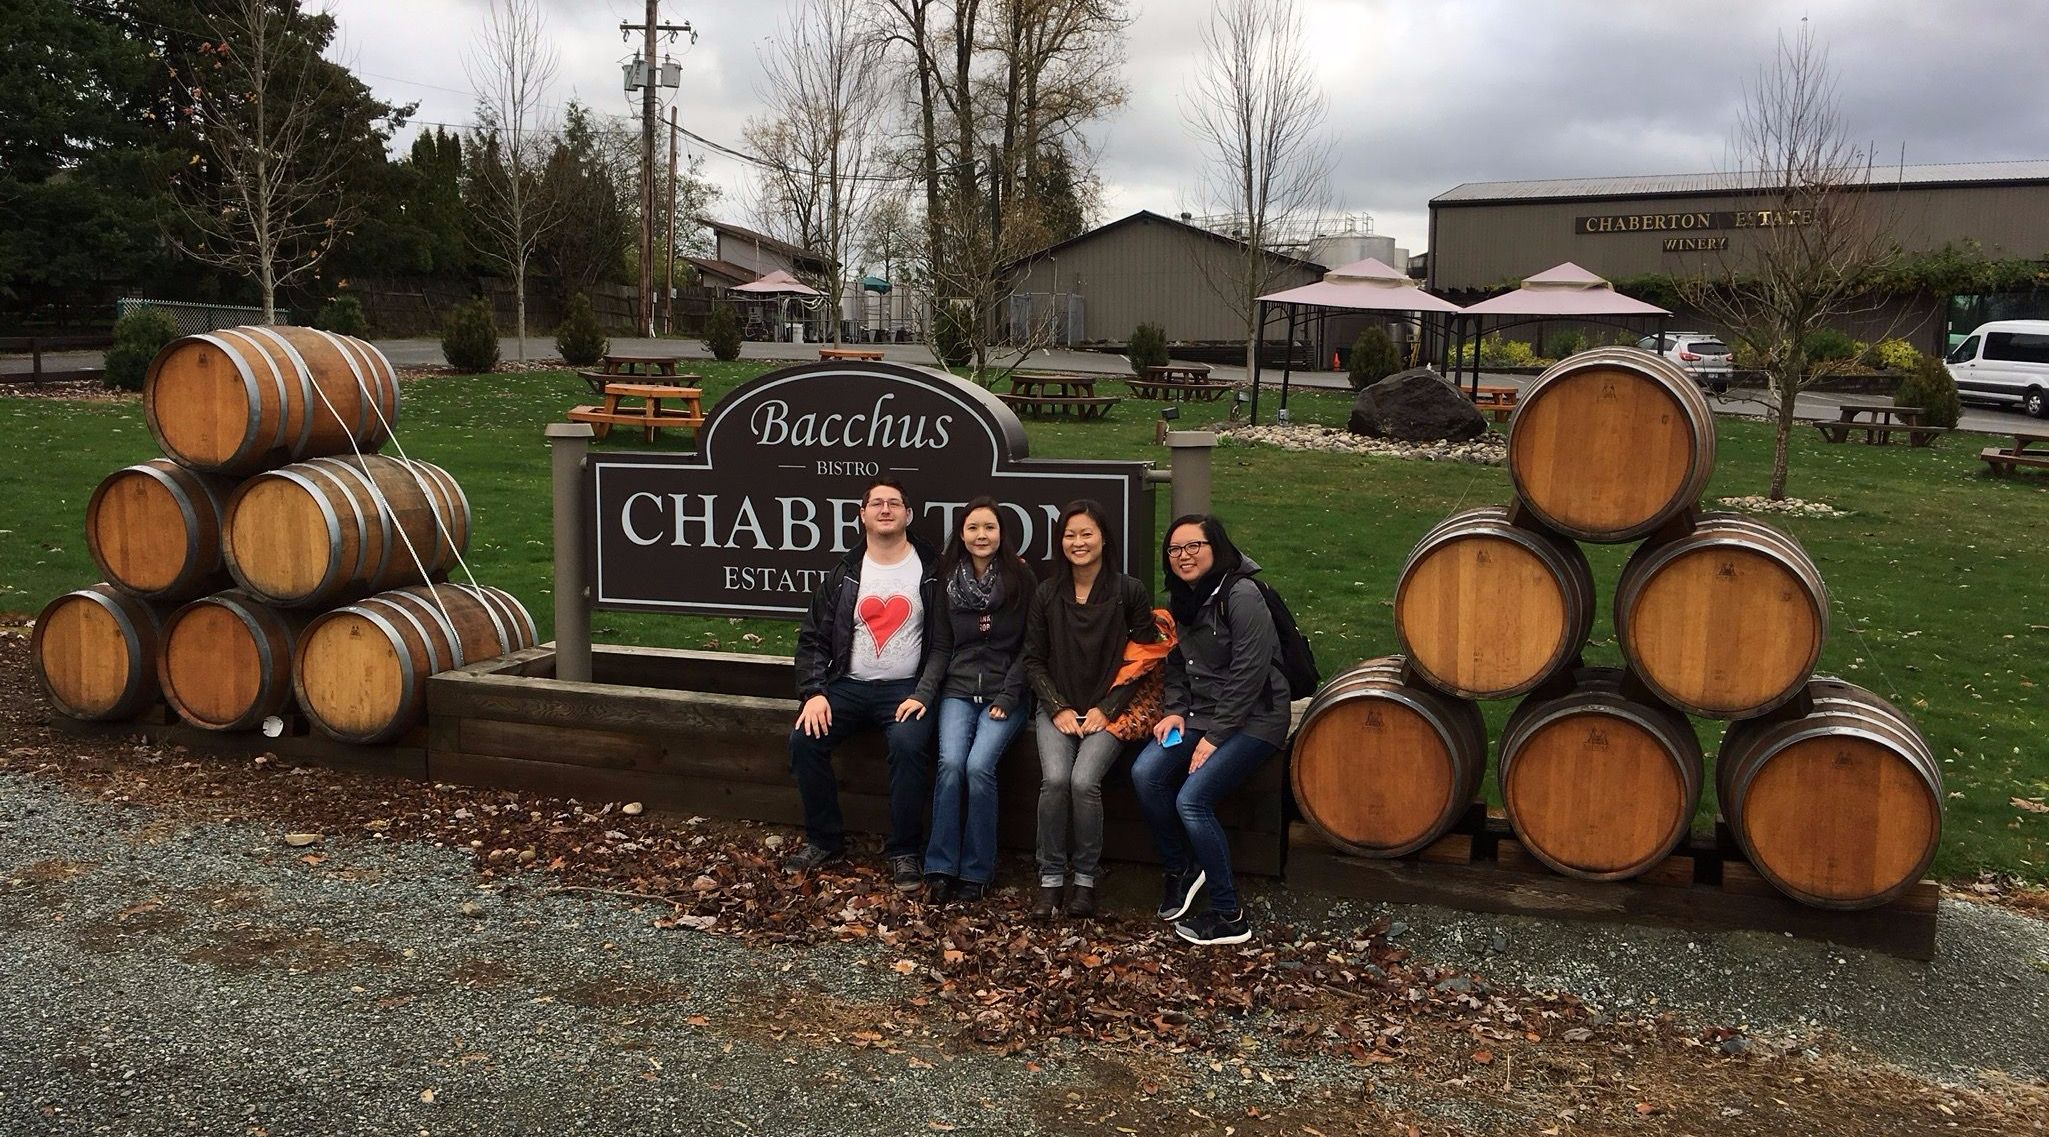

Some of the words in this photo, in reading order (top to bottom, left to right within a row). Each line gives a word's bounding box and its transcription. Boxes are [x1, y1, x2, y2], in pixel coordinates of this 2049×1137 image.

[1586, 213, 1711, 232] CHABERTON
[1664, 238, 1725, 250] WINERY
[750, 392, 951, 449] Bacchus
[817, 460, 879, 476] BISTRO
[621, 492, 1061, 561] CHABETO
